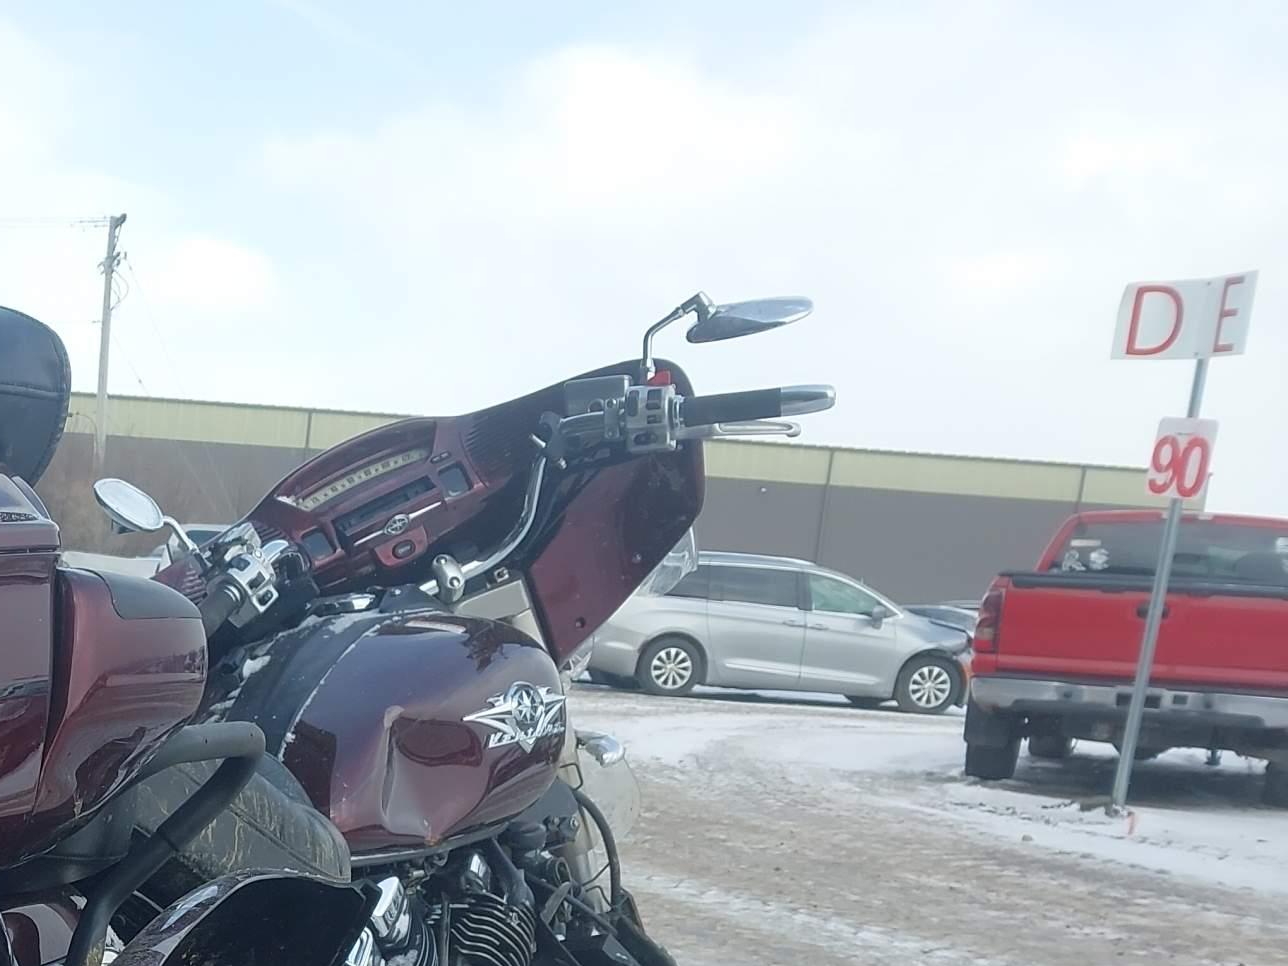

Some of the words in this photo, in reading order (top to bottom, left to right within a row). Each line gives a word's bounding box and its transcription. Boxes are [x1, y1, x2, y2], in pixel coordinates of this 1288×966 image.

[1125, 285, 1184, 355] D
[1212, 275, 1246, 353] E
[1148, 434, 1210, 498] 90
